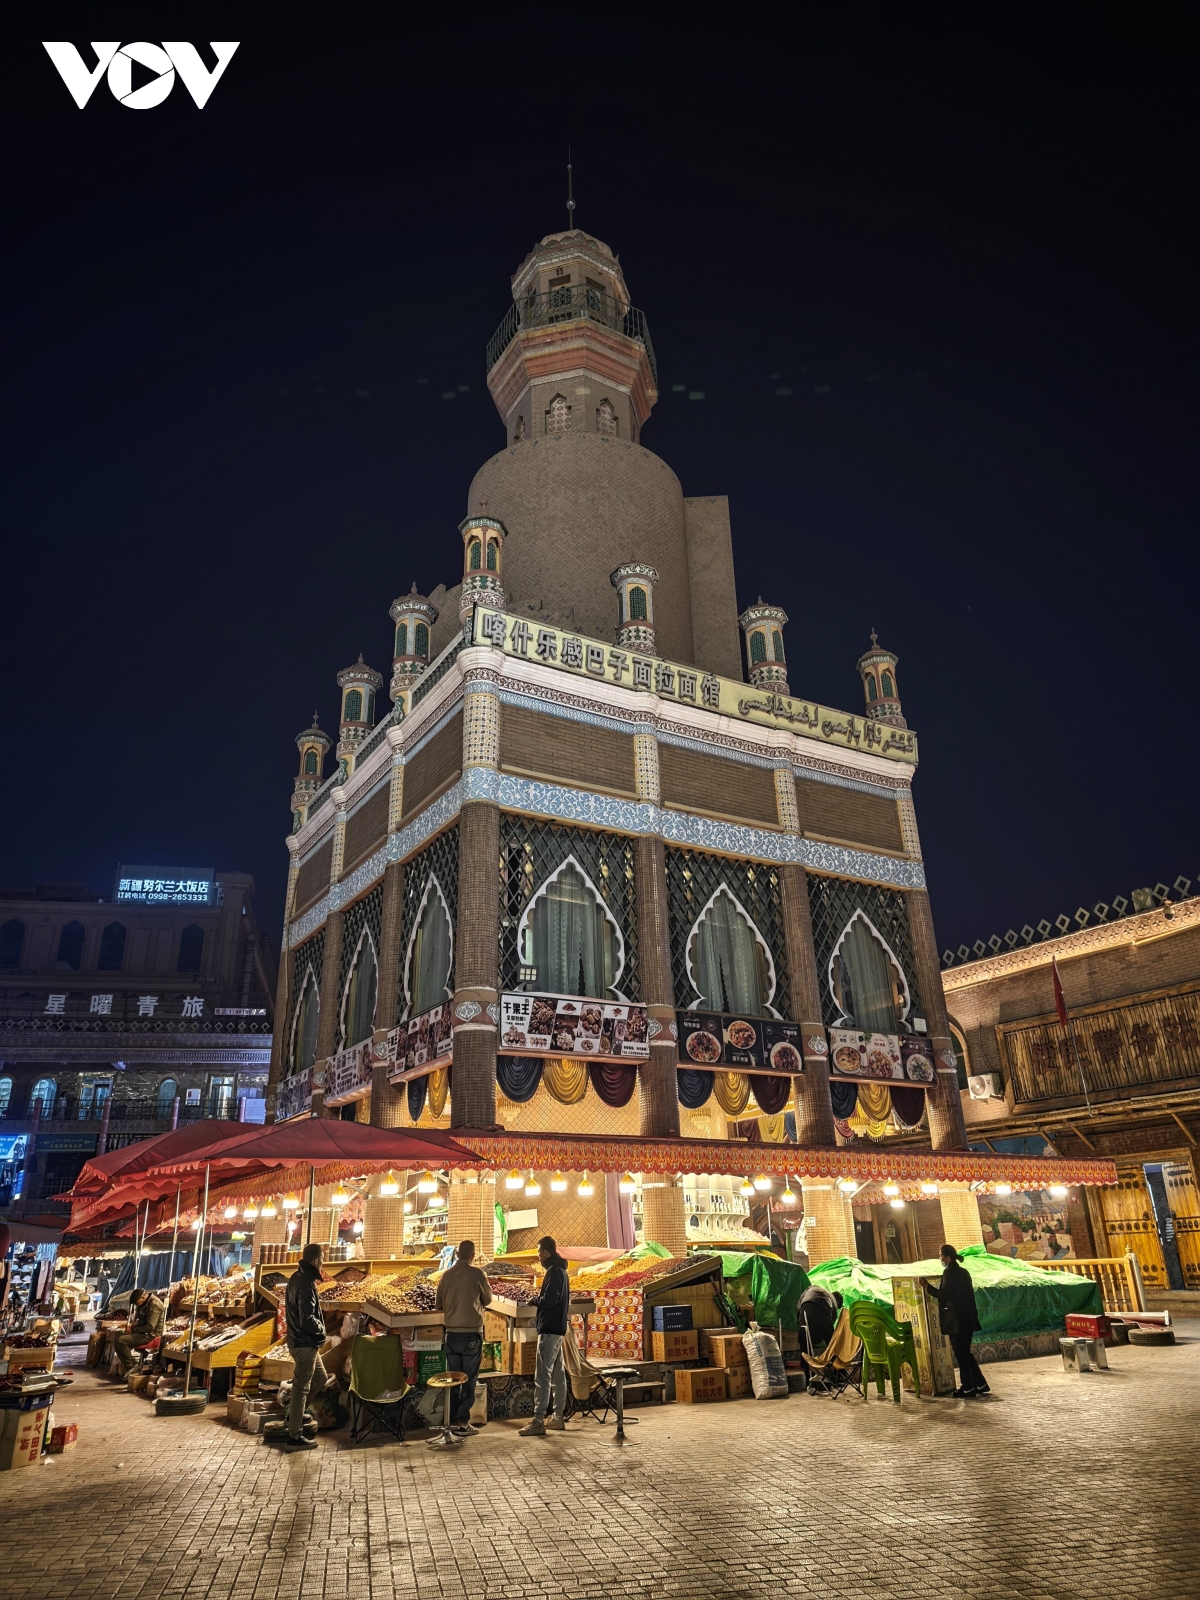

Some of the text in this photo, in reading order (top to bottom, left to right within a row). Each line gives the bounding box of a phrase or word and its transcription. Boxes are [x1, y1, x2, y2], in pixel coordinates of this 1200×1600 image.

[482, 613, 721, 708] 喀什乐感巴子面拉面馆
[118, 878, 210, 894] 新疆努尔兰大饭店
[148, 892, 208, 901] 0998-2653333
[44, 993, 206, 1018] 星曜青旅
[502, 1001, 530, 1015] 干果王
[667, 1346, 695, 1358] 和田大枣
[695, 1386, 723, 1398] 和田大枣
[28, 1411, 44, 1462] 和田大枣
